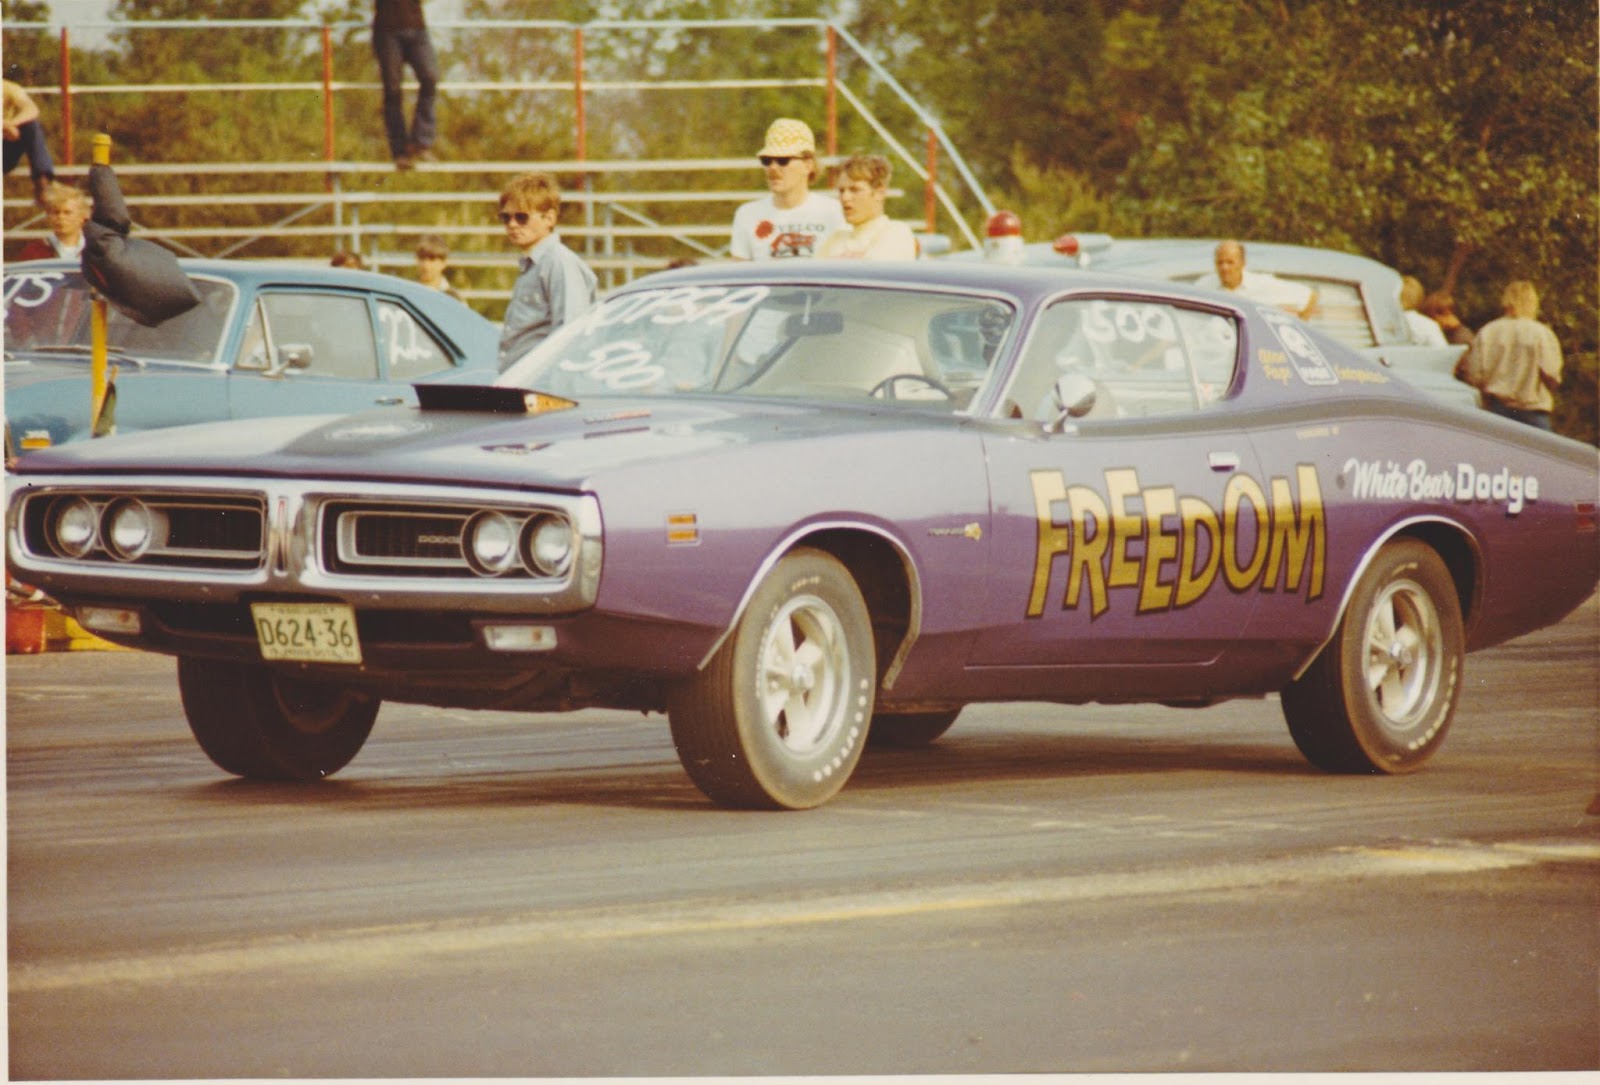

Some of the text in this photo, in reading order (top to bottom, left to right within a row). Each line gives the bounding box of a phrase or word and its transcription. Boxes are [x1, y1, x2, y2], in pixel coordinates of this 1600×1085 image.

[1344, 458, 1539, 514] White Bear Dodge
[1024, 462, 1326, 623] FREEDOM
